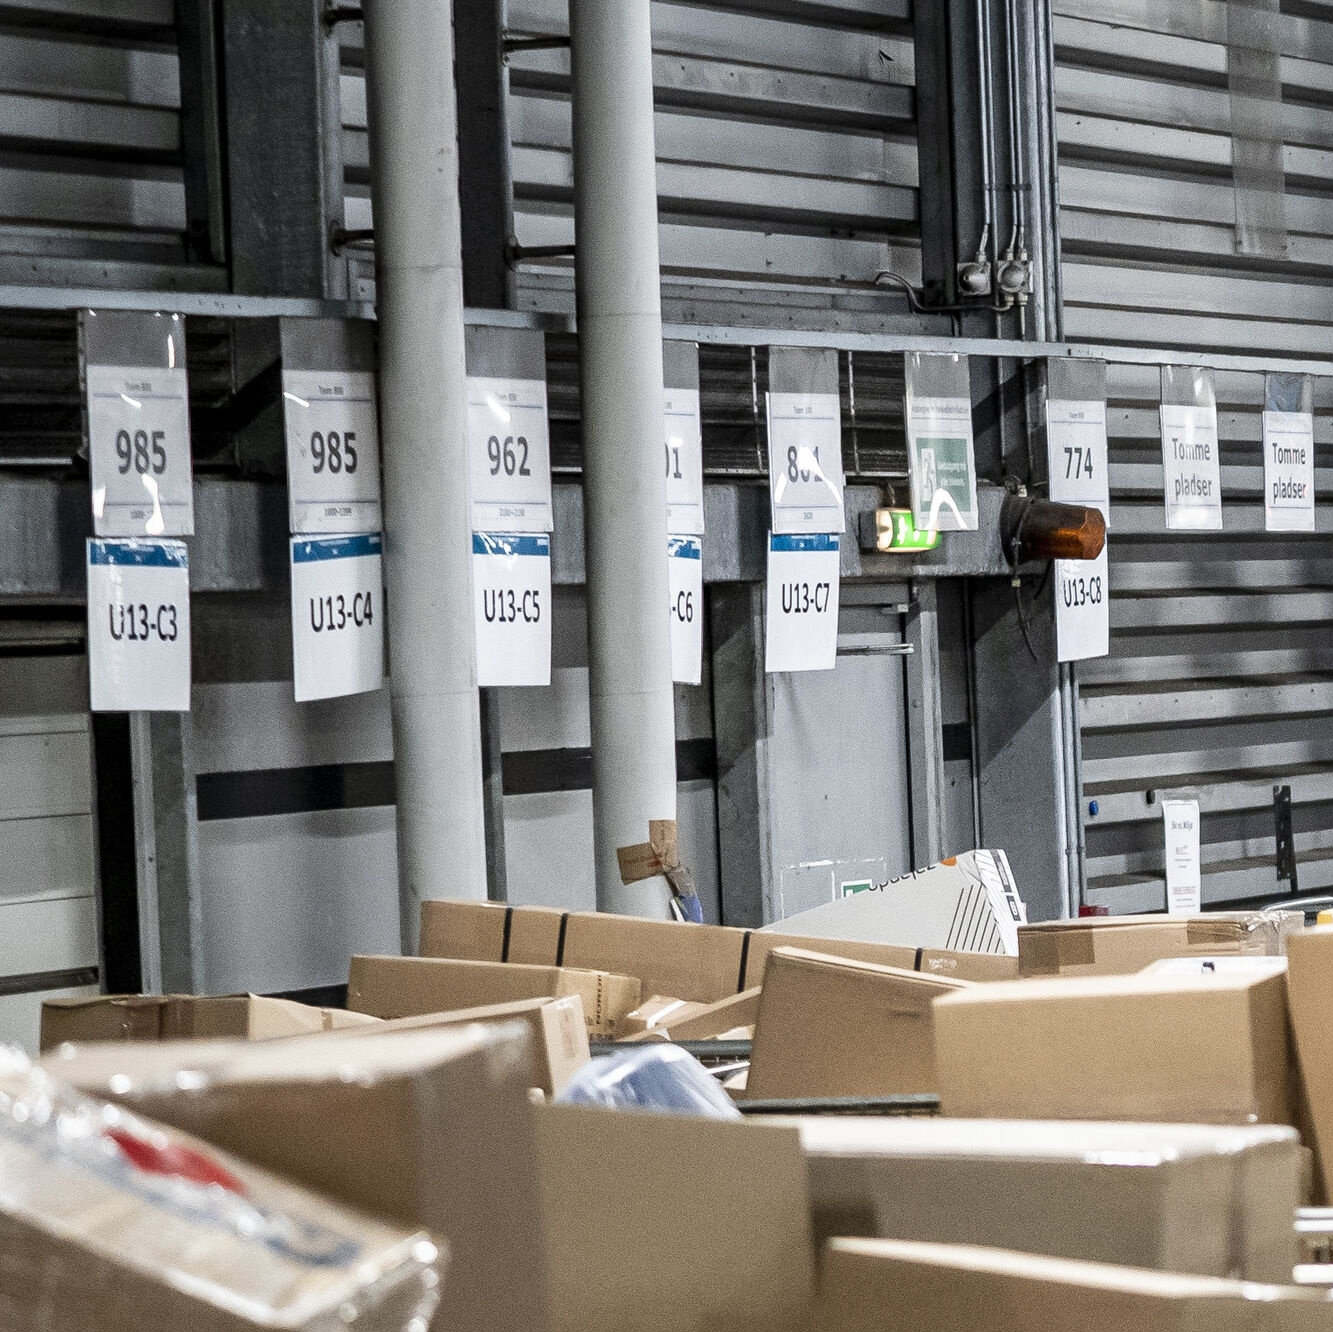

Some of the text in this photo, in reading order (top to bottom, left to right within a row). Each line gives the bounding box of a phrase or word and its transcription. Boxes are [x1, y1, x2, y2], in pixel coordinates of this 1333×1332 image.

[116, 430, 166, 475] 985
[311, 431, 357, 473] 985
[488, 435, 530, 476] 962
[1064, 447, 1093, 479] 774
[1172, 437, 1210, 461] Tomme
[1272, 442, 1306, 465] Tomme
[1175, 475, 1212, 499] pladser
[1273, 479, 1306, 503] pladser
[483, 590, 541, 624] U13-C5
[781, 582, 830, 614] U13-C7
[1063, 576, 1102, 608] U13-C8
[109, 604, 178, 642] U13-C3
[310, 591, 374, 633] U13-C4
